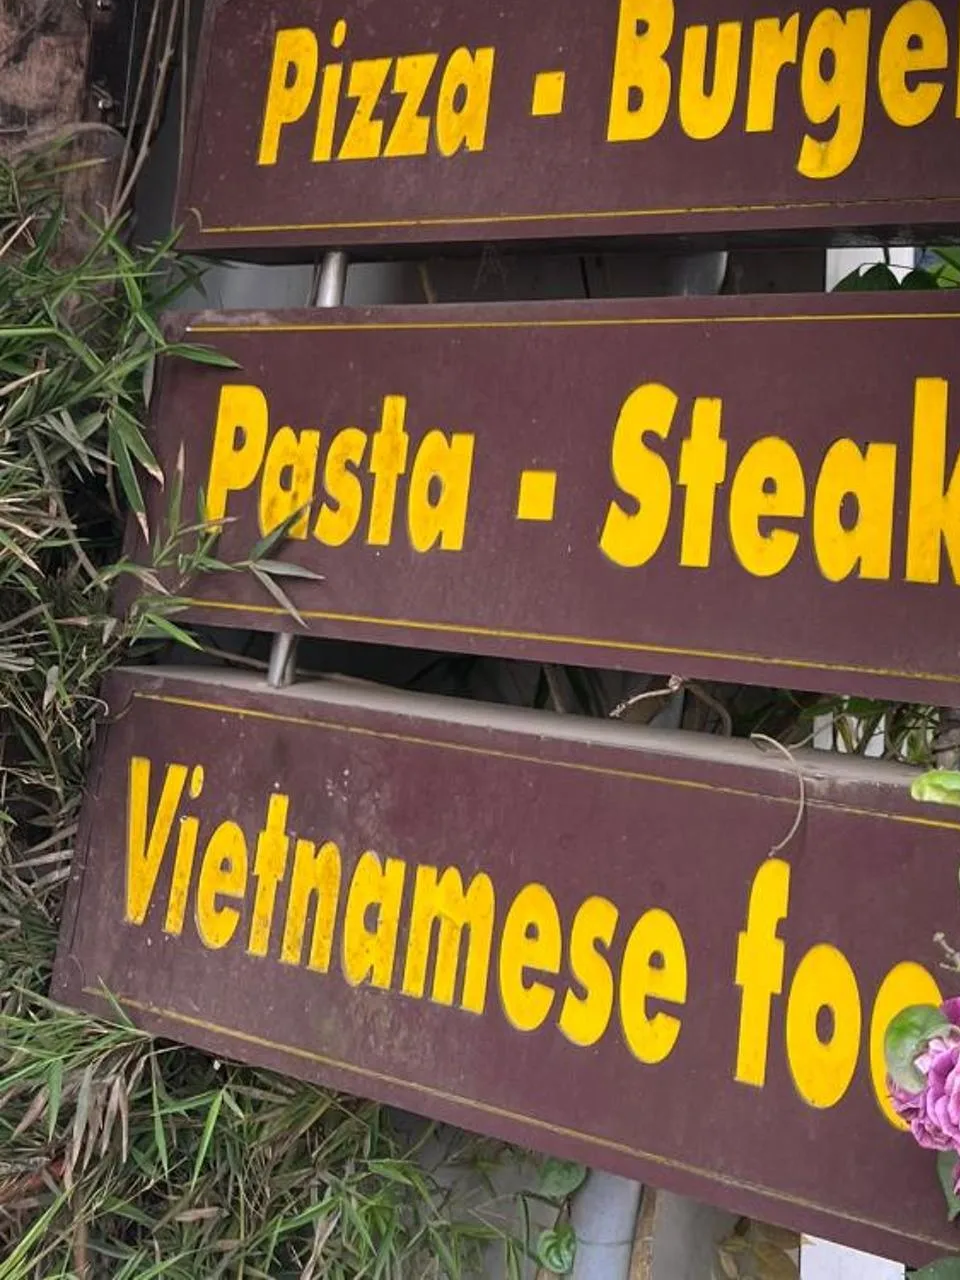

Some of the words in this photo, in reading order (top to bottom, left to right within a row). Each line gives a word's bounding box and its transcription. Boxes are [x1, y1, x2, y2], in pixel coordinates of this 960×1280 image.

[257, 19, 494, 167] Pizza
[203, 384, 475, 554] Pasta
[124, 757, 688, 1063] Vietnamese
